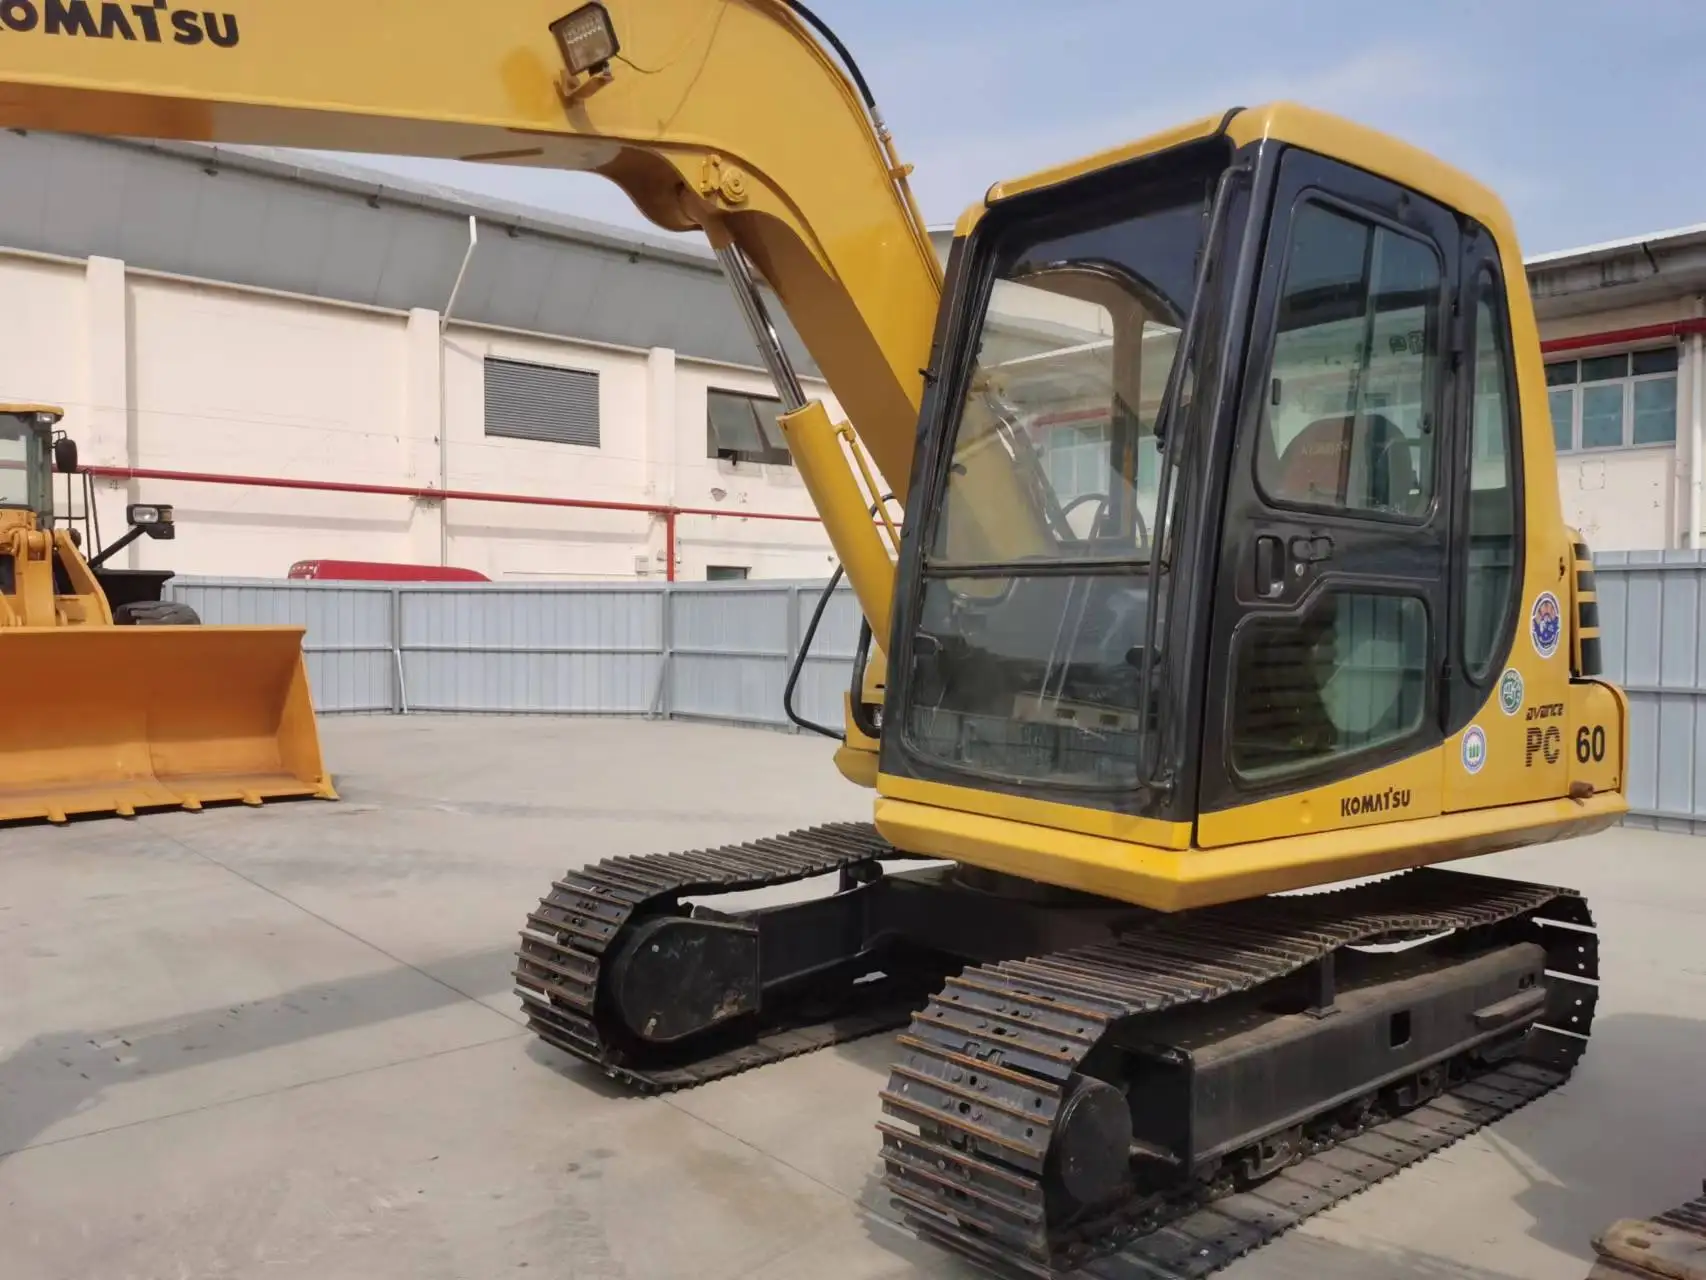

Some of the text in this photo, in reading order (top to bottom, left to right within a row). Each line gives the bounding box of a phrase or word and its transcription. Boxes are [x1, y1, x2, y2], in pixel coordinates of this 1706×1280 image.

[0, 0, 239, 48] OMATSU
[1525, 726, 1560, 767] PC
[1576, 725, 1605, 763] 60
[1341, 786, 1411, 817] KOMATSU
